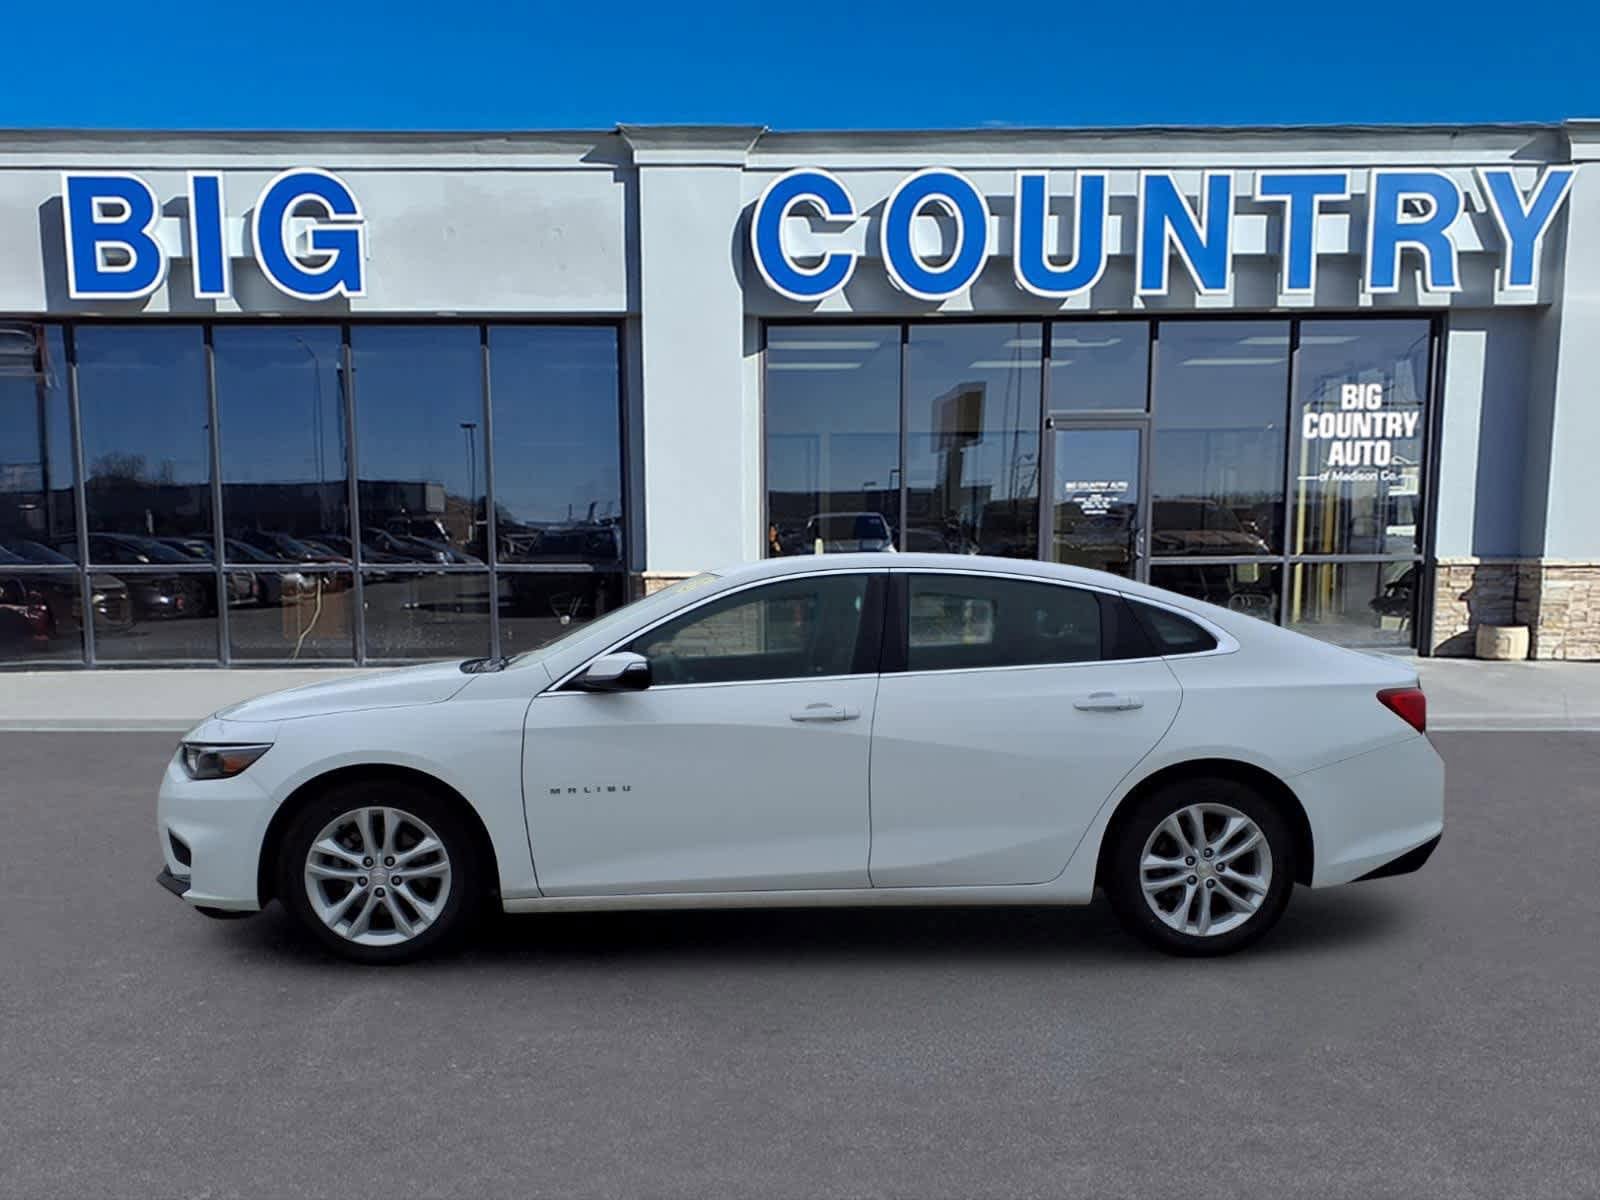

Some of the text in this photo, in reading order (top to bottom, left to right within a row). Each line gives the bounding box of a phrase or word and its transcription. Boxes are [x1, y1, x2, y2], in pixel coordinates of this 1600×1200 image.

[62, 166, 1577, 302] BIG COUNTRY
[1342, 384, 1382, 410] BIG
[1303, 411, 1419, 438] COUNTRY
[1329, 440, 1391, 466] AUTO
[1319, 470, 1330, 482] of
[1332, 470, 1378, 481] Madison
[550, 784, 632, 795] MALIBU
